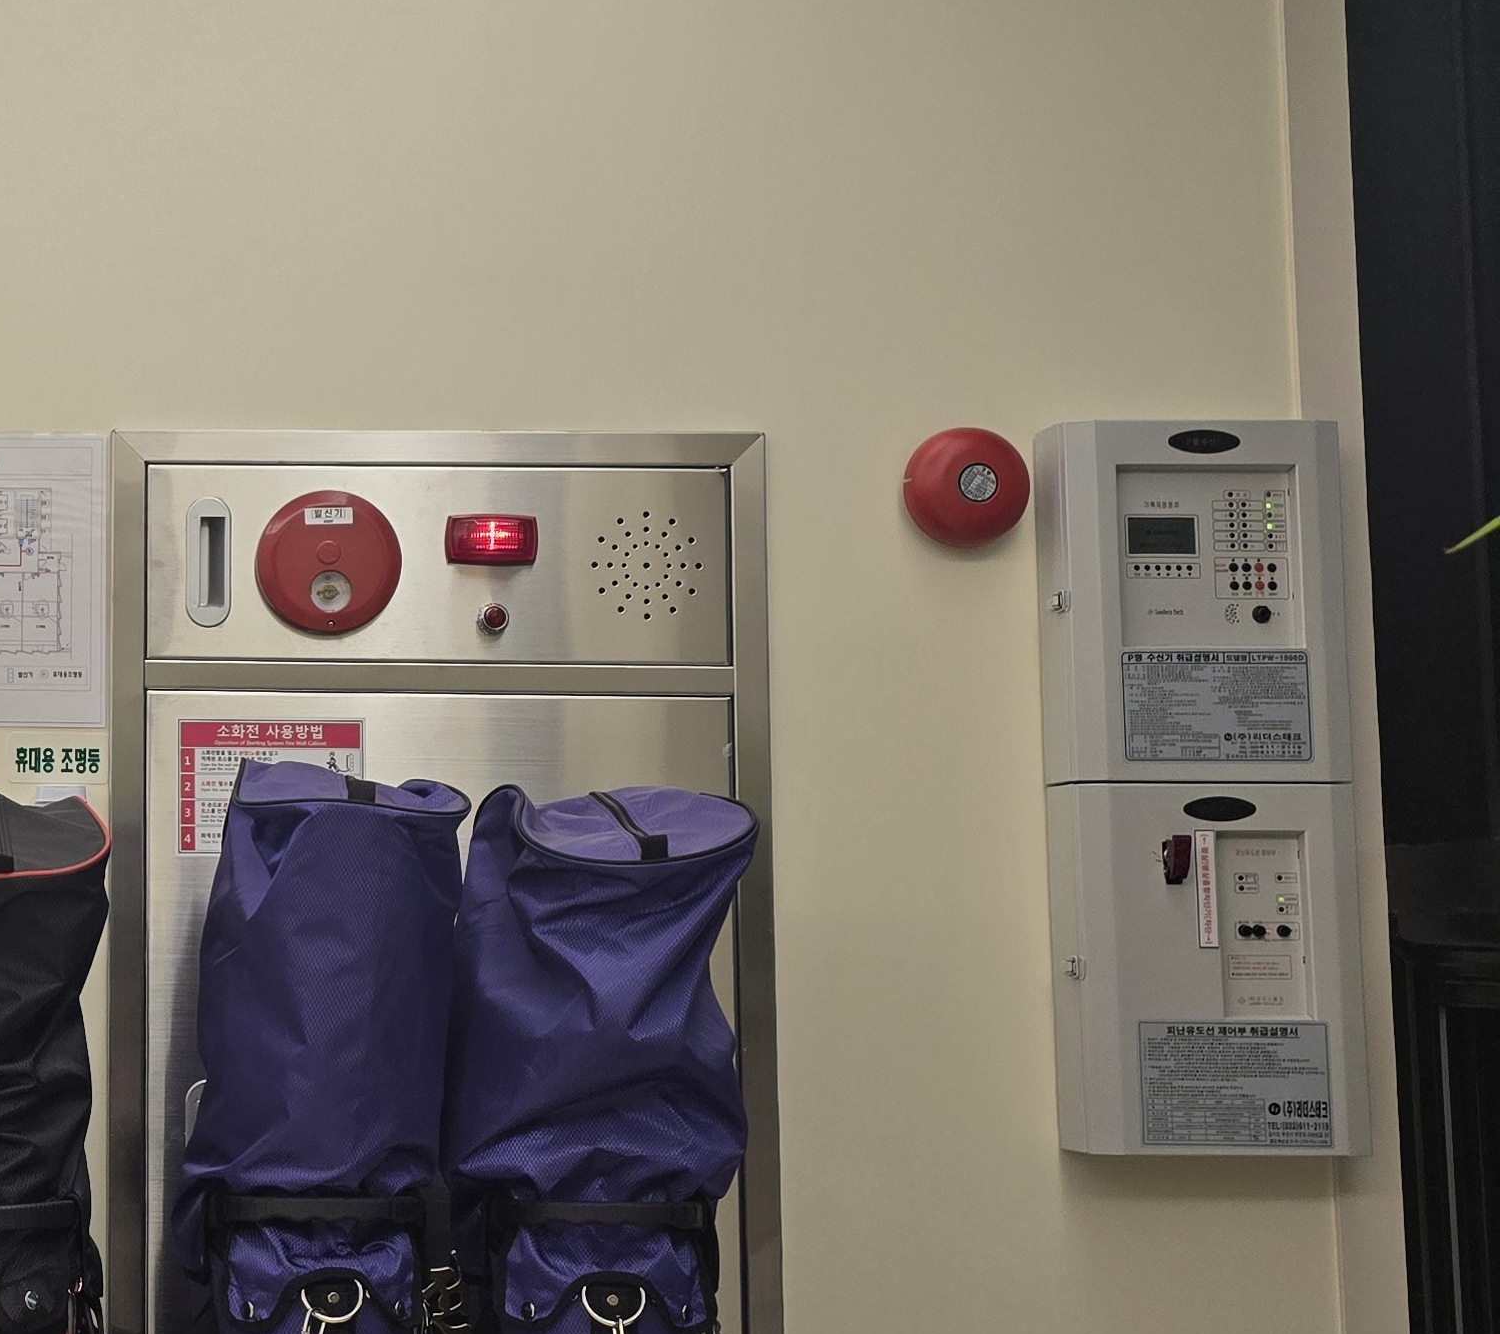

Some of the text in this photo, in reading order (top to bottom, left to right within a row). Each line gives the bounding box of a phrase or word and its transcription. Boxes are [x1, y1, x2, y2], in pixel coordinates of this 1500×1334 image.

[314, 509, 343, 518] 발신기
[1147, 654, 1173, 662] 수신기
[1176, 654, 1219, 662] 취급설명서
[216, 724, 323, 739] 소화전 사용방법
[15, 747, 100, 773] 휴대용 조명등
[184, 756, 191, 765] 1
[184, 782, 191, 791] 2
[184, 808, 191, 817] 3
[184, 834, 191, 843] 4
[1166, 1026, 1299, 1036] 피난유도선 제어부 취급설명서
